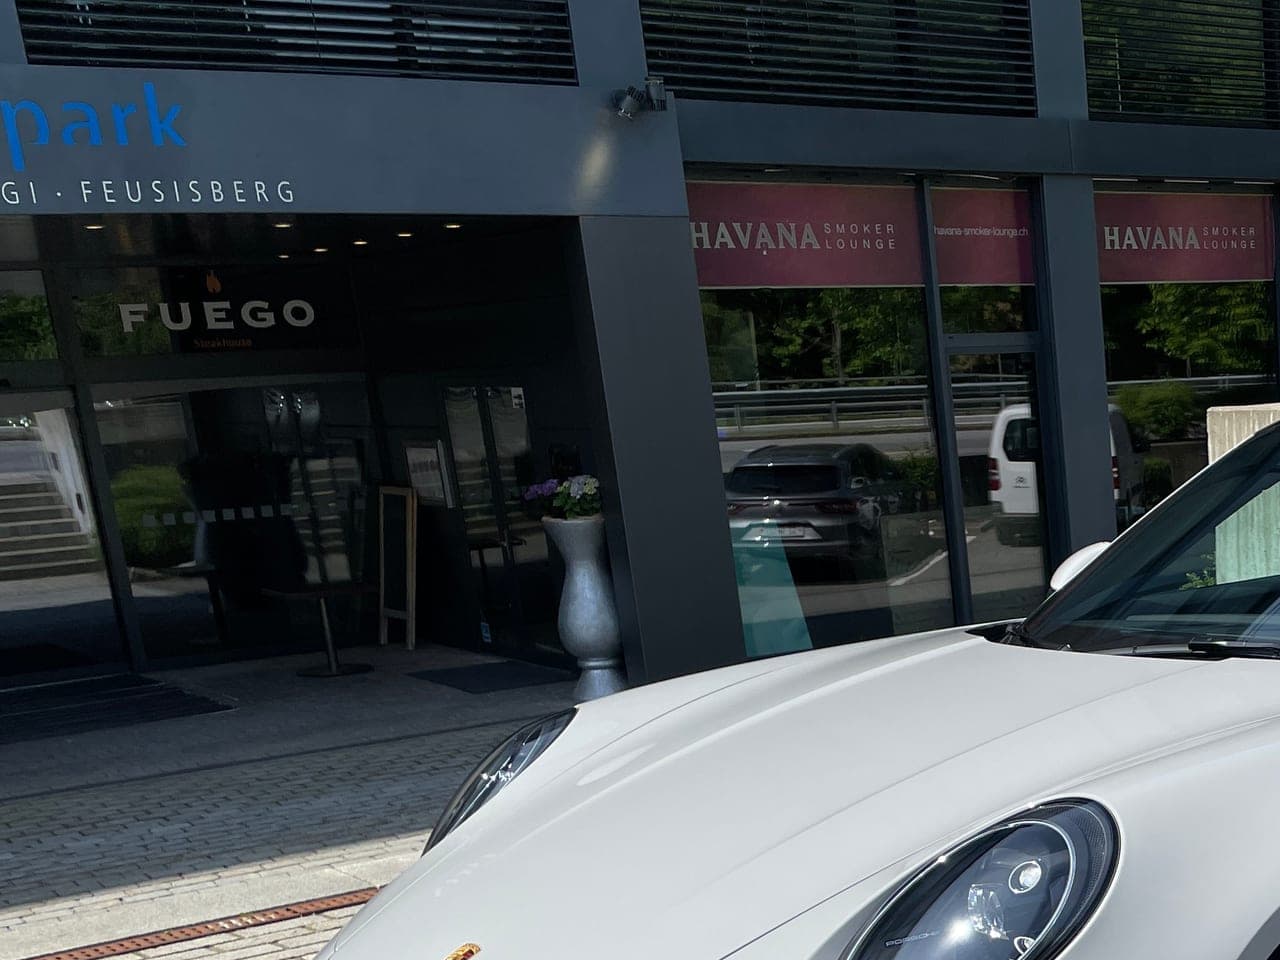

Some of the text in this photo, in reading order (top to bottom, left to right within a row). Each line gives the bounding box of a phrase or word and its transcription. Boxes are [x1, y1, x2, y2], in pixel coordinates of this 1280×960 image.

[0, 82, 187, 172] park
[80, 180, 294, 203] FEUSISBERG
[690, 222, 821, 249] HAVANA
[823, 223, 895, 235] SMOKER
[933, 225, 1029, 238] havana-smoker-lounge.ch
[1103, 226, 1200, 250] HAVANA
[1202, 226, 1256, 236] SMOKER
[825, 239, 895, 249] LOUNGE
[1203, 240, 1256, 249] LOUNGE
[120, 299, 315, 333] FUEGO
